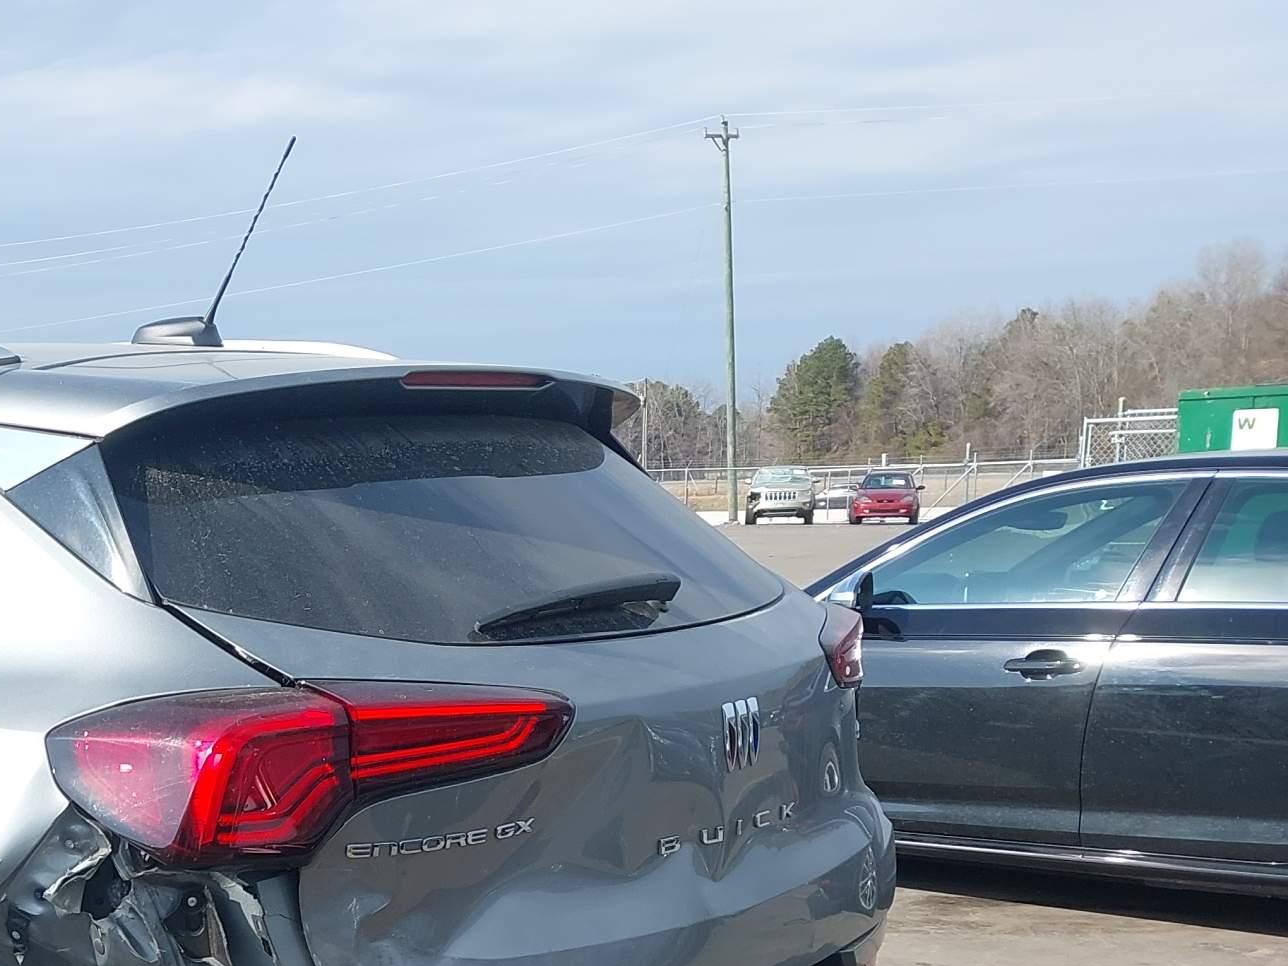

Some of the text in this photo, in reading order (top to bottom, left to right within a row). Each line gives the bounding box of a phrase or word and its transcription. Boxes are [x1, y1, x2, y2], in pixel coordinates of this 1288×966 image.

[1238, 416, 1256, 430] W
[345, 817, 536, 859] ENCORE GX
[658, 802, 796, 857] BUICK
